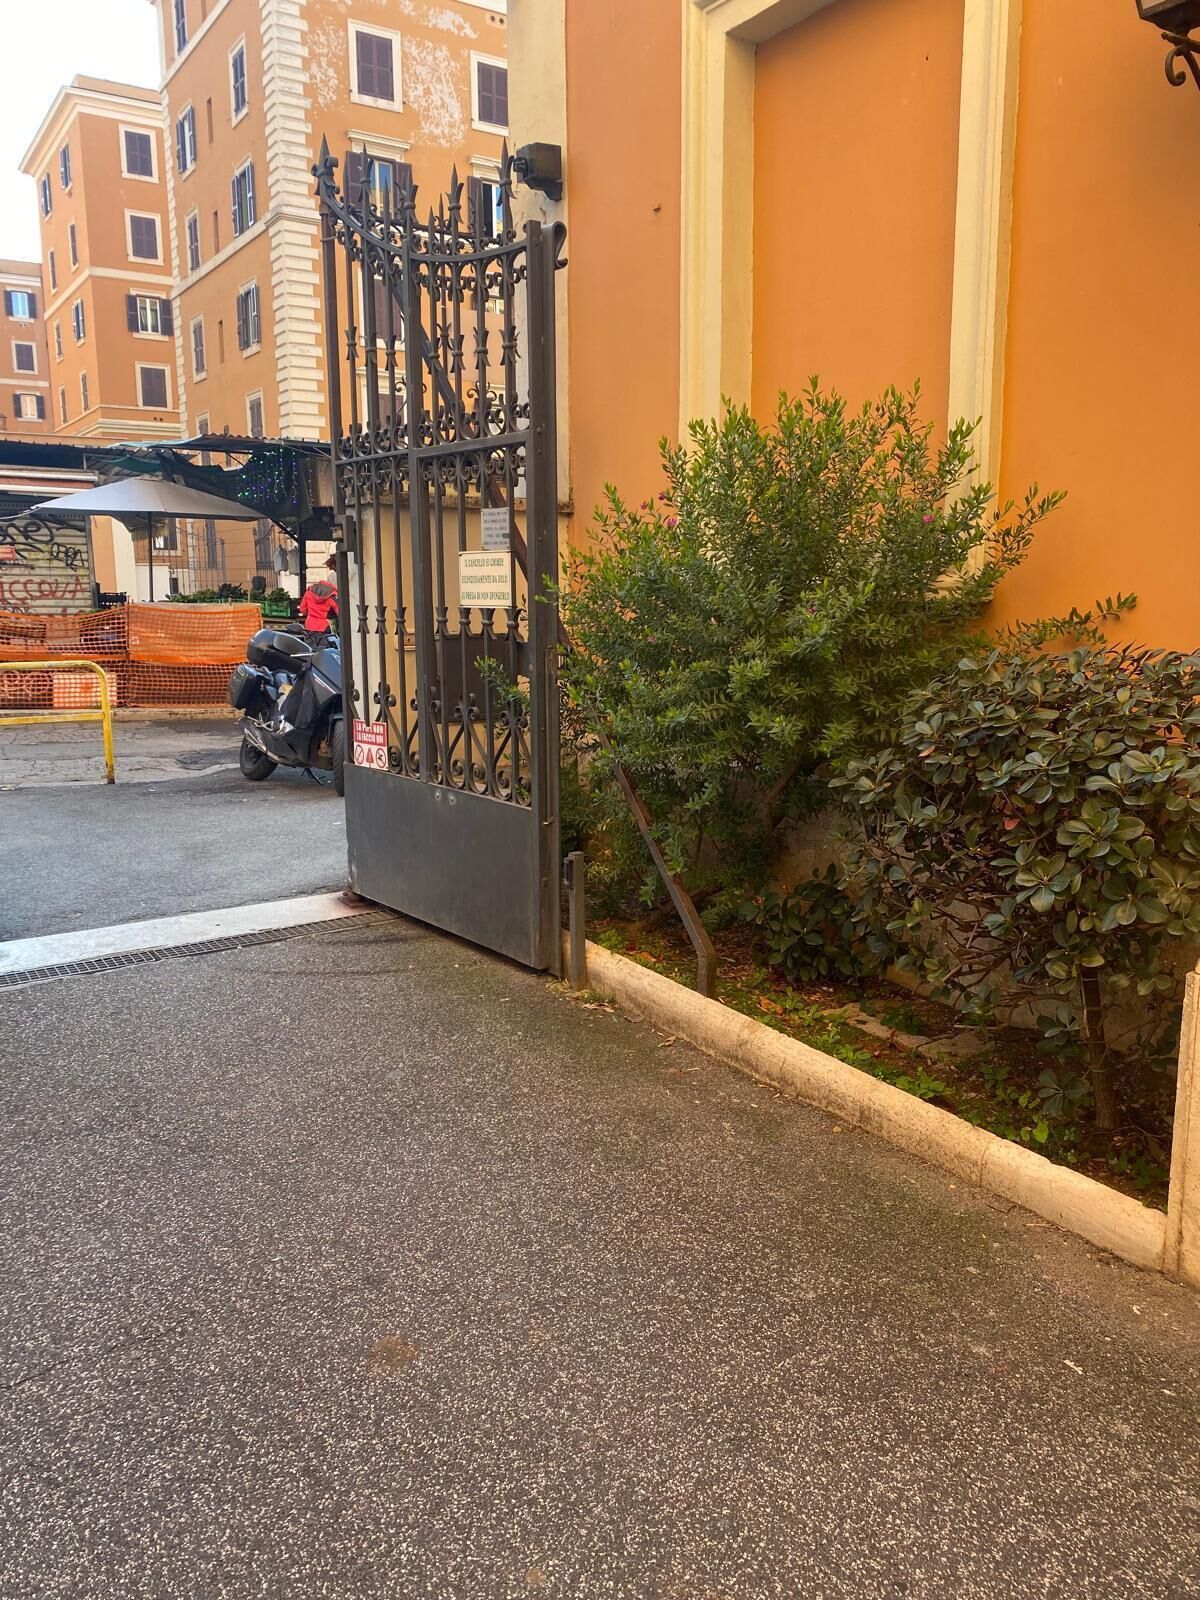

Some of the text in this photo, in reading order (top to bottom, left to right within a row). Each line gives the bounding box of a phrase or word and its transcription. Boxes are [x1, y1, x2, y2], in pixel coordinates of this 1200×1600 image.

[468, 558, 485, 567] CANCELLO
[492, 575, 498, 583] DA
[498, 574, 508, 583] SOLO
[465, 592, 476, 600] PREGA
[481, 592, 489, 600] NON
[356, 722, 361, 730] LA
[373, 724, 384, 734] NON
[356, 732, 361, 740] LA
[362, 733, 376, 743] FACCIO
